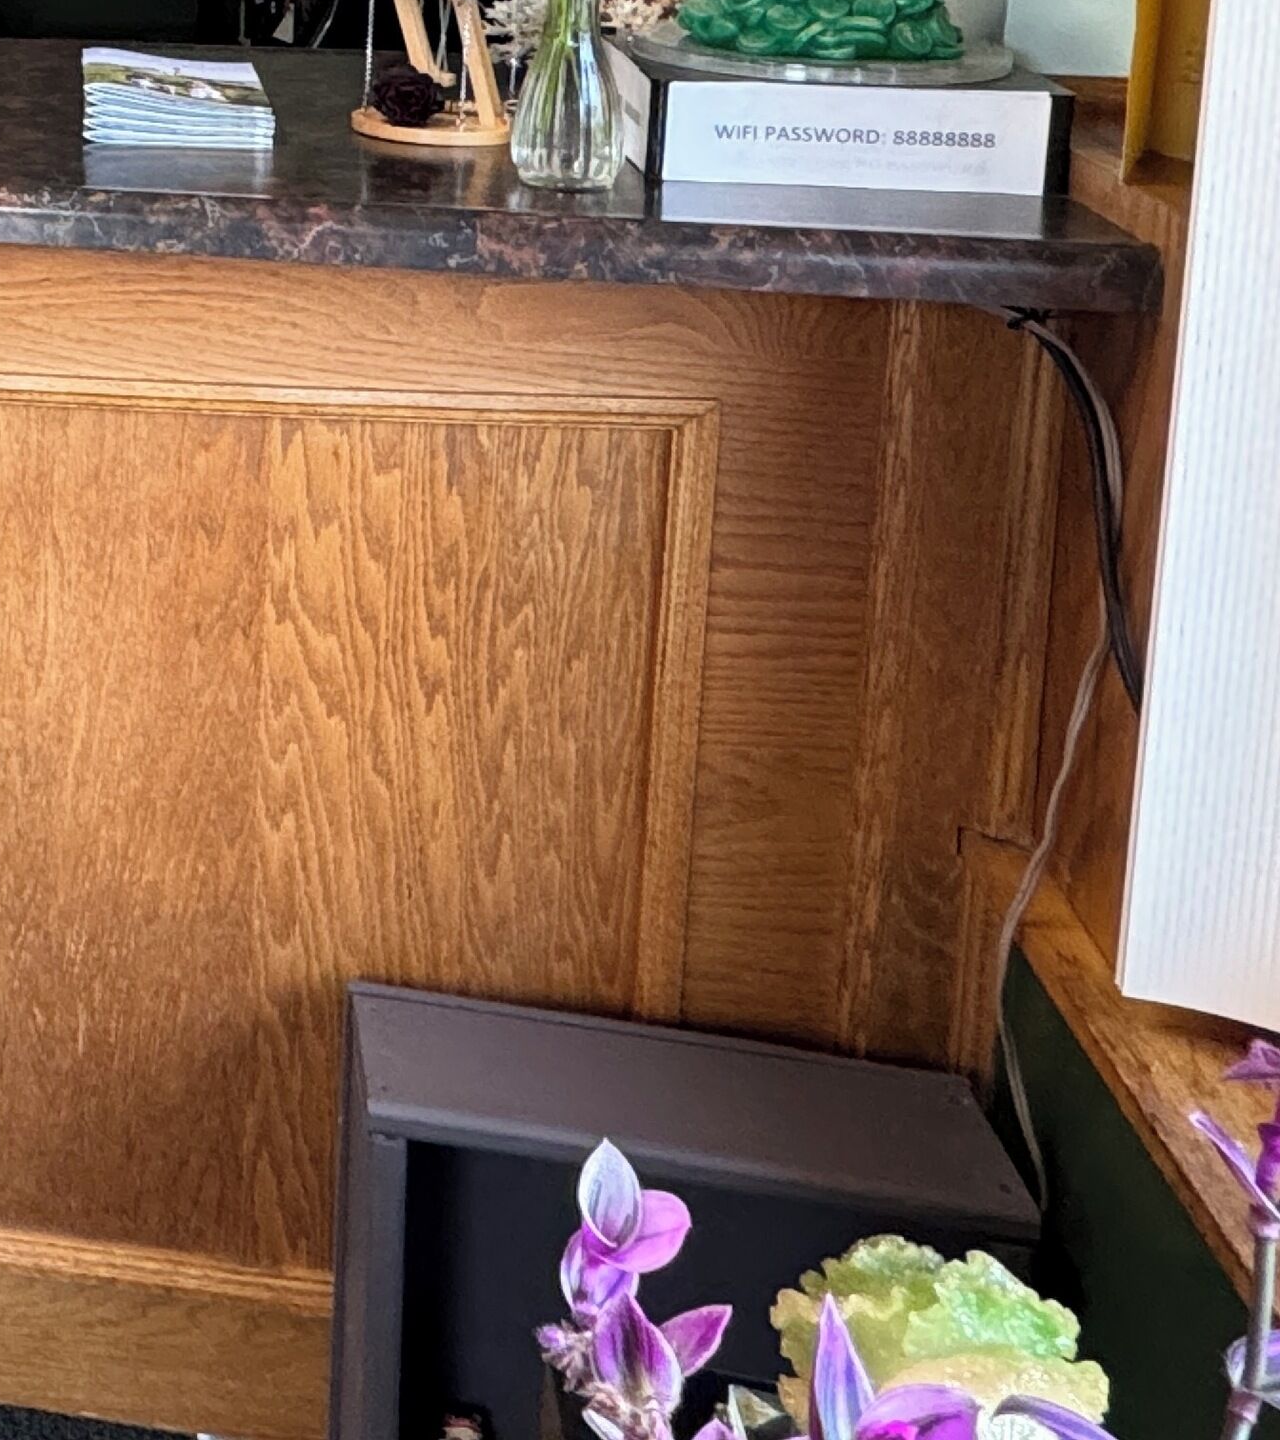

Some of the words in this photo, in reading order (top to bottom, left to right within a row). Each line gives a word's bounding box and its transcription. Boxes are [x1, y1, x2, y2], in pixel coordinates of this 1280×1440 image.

[714, 123, 758, 142] WIFI
[764, 125, 888, 146] PASSWORD:
[892, 129, 996, 149] 88888888
